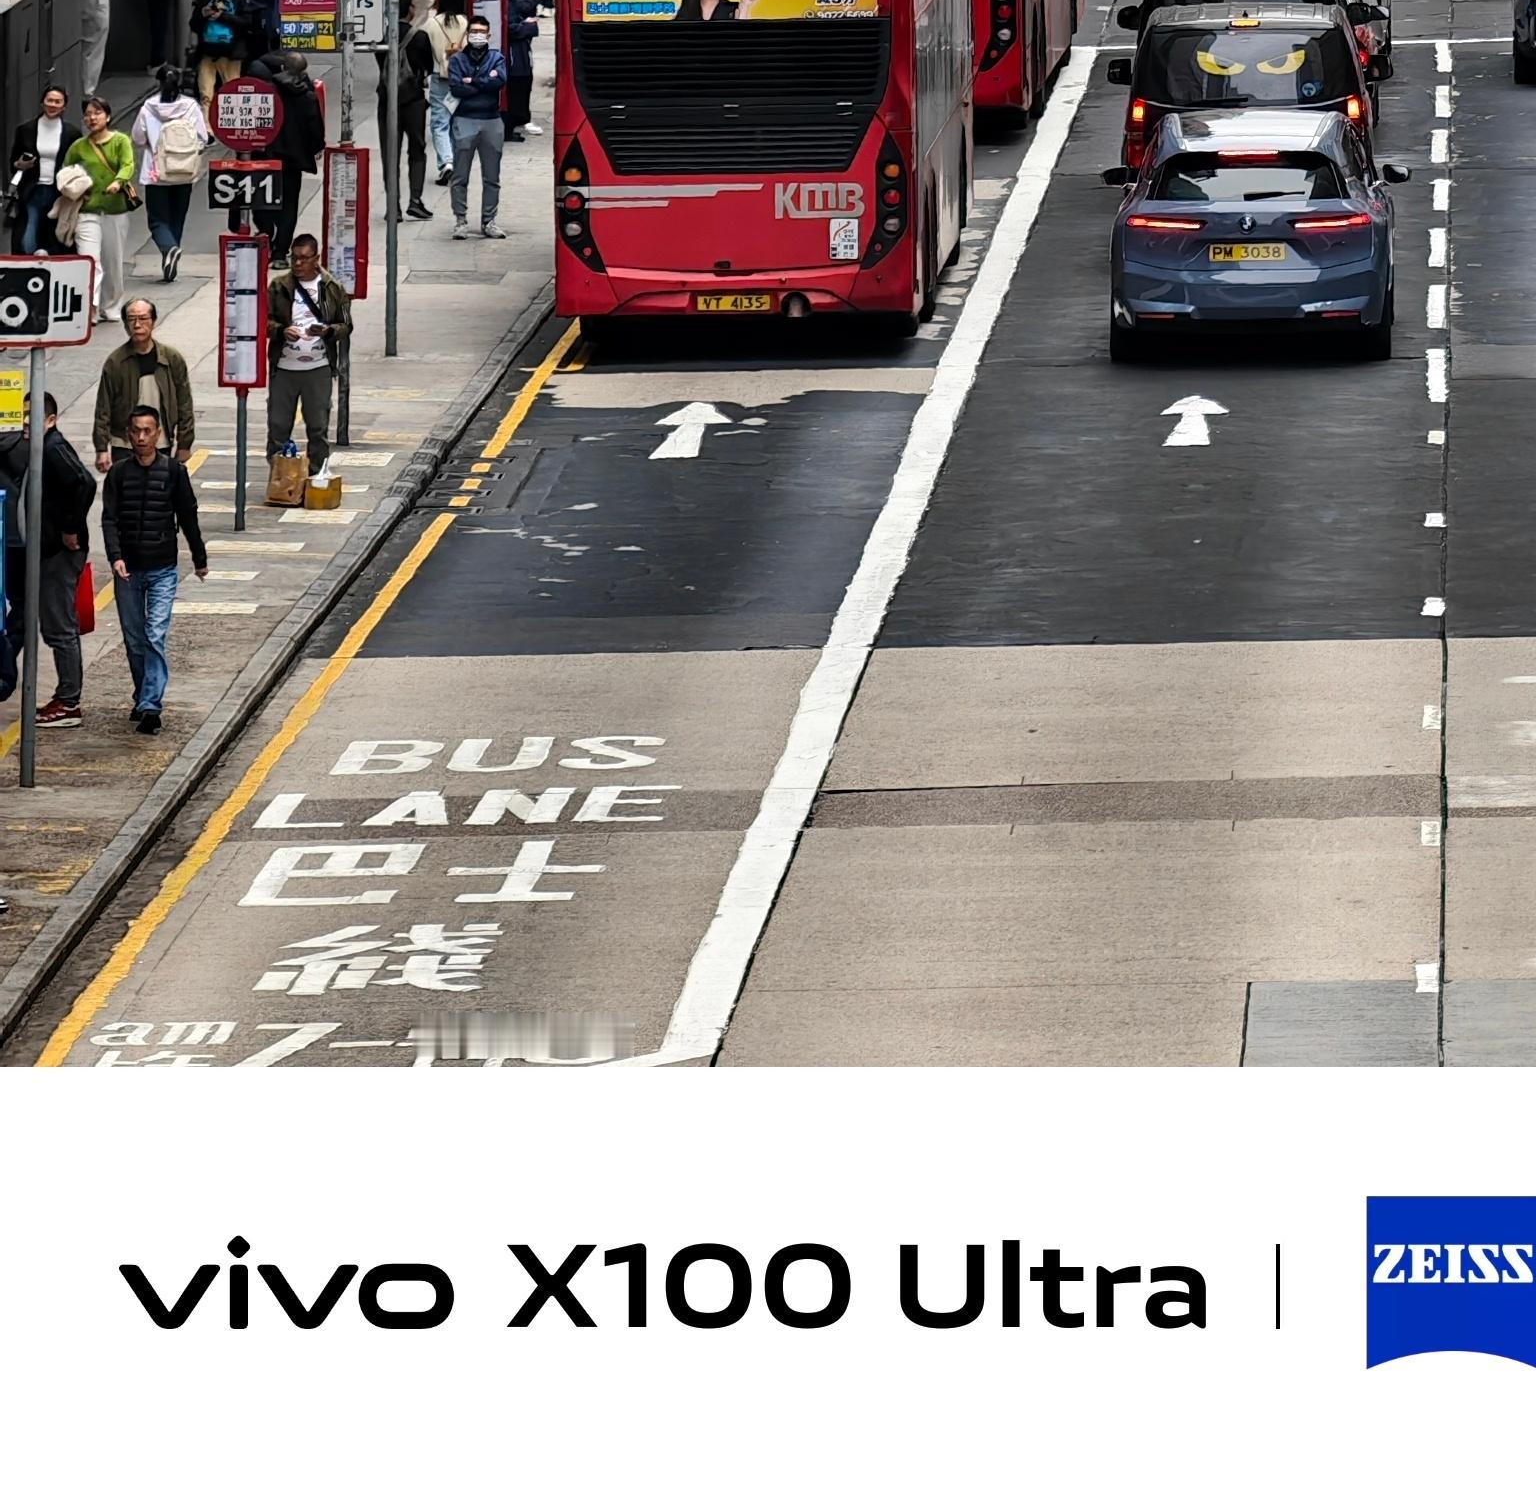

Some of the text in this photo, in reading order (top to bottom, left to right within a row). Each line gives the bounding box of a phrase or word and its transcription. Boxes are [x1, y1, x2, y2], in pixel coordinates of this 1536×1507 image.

[775, 182, 865, 219] KMB
[1211, 245, 1283, 260] PM 3038
[703, 297, 722, 310] VT
[330, 735, 667, 775] BUS
[251, 785, 682, 829] LANE
[238, 840, 606, 906] 巴士
[89, 1021, 237, 1047] am
